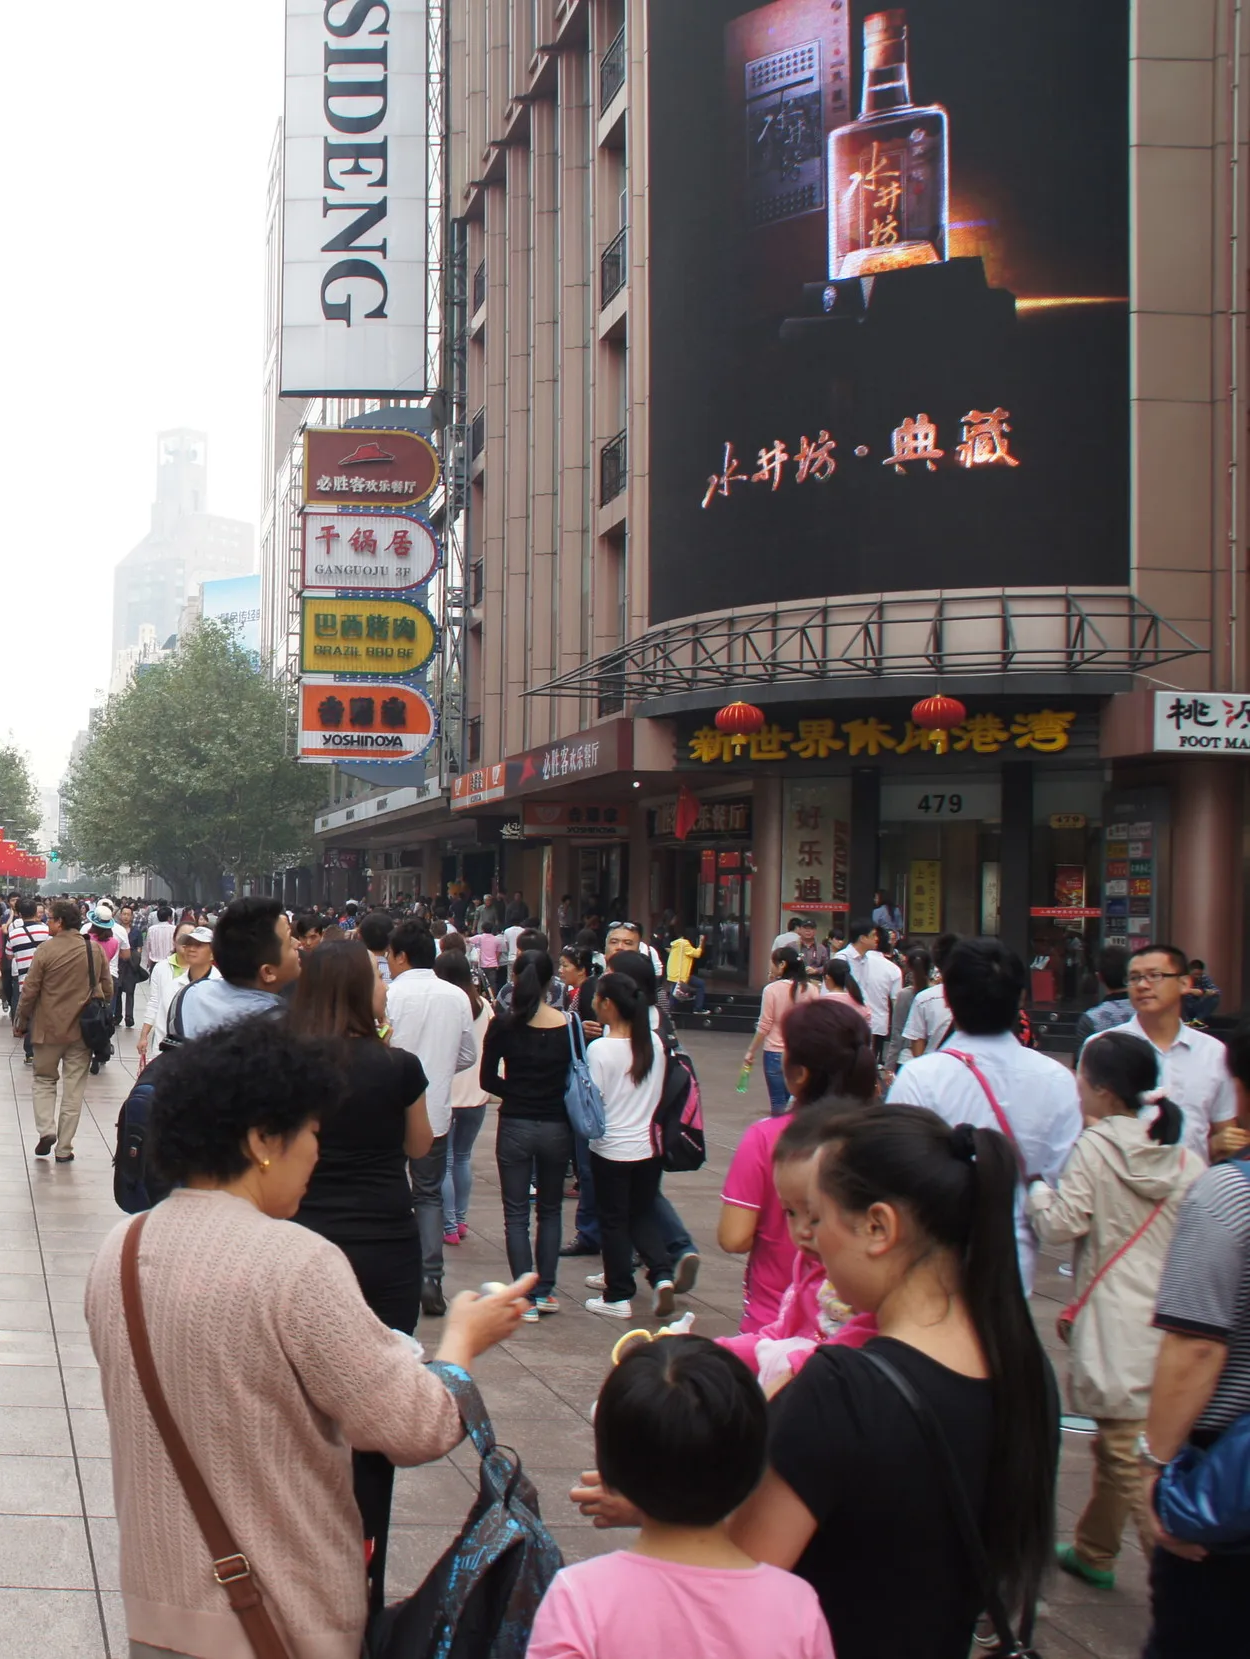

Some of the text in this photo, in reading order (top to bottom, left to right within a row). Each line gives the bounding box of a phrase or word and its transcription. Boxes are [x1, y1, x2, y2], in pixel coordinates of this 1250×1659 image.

[316, 475, 417, 494] 必胜客欢乐餐厅
[315, 524, 413, 557] 干锅居
[315, 564, 412, 578] GANGUOJU 3F
[315, 614, 417, 641] 巴西烤肉
[314, 646, 362, 657] BRAZIL
[322, 734, 404, 747] YOSHINOYA
[1179, 735, 1222, 748] FOOT
[542, 741, 599, 781] 必胜客欢乐餐厅
[918, 794, 963, 813] 479
